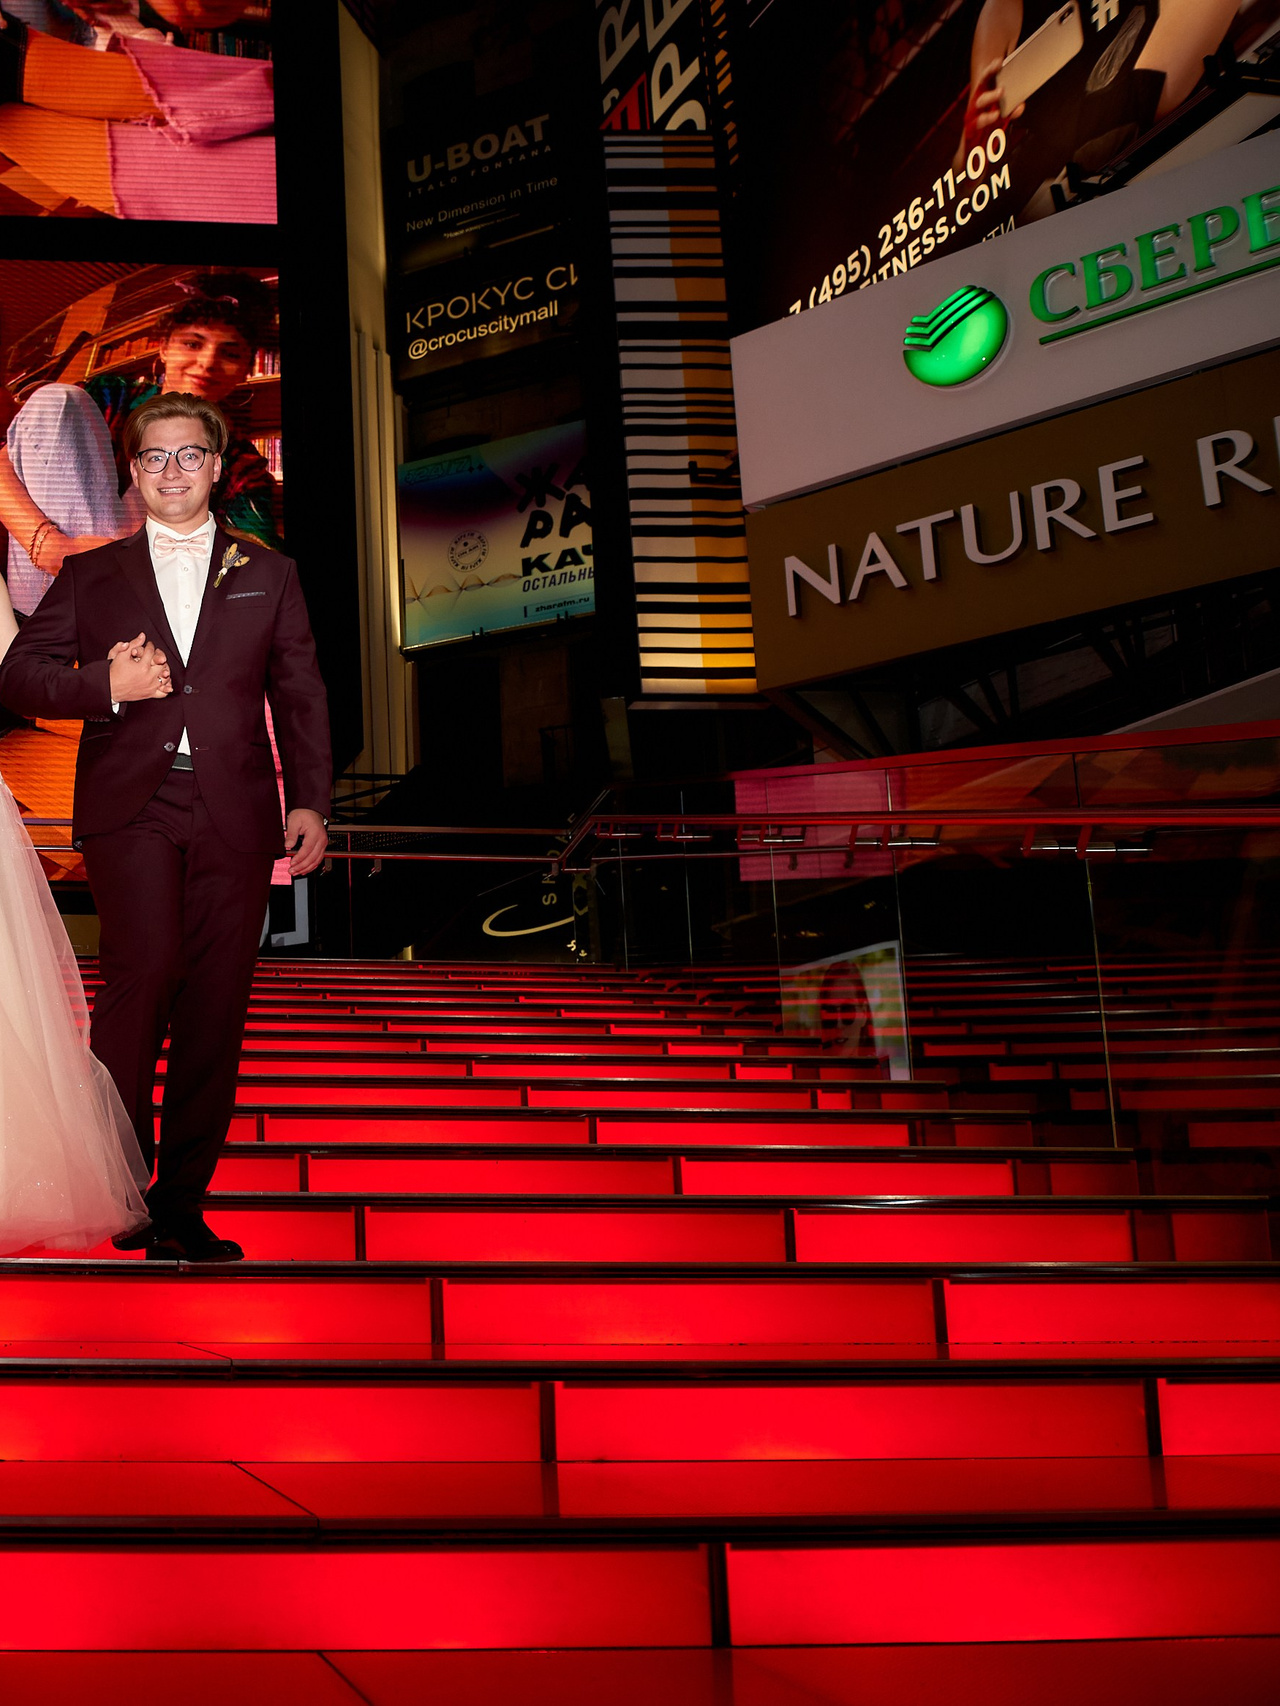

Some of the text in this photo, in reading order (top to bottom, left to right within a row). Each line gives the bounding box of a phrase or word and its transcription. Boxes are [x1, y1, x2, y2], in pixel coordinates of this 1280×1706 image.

[406, 112, 551, 183] U-BOAT
[406, 214, 434, 232] New
[437, 193, 506, 223] Dimension
[509, 188, 522, 200] in
[525, 176, 558, 194] Time
[408, 176, 458, 199] ITALO
[877, 128, 1007, 260] 236-11-00
[406, 276, 535, 334] КРОКУС
[407, 299, 559, 360] @crocuscitymall
[784, 415, 1280, 617] NATURE R
